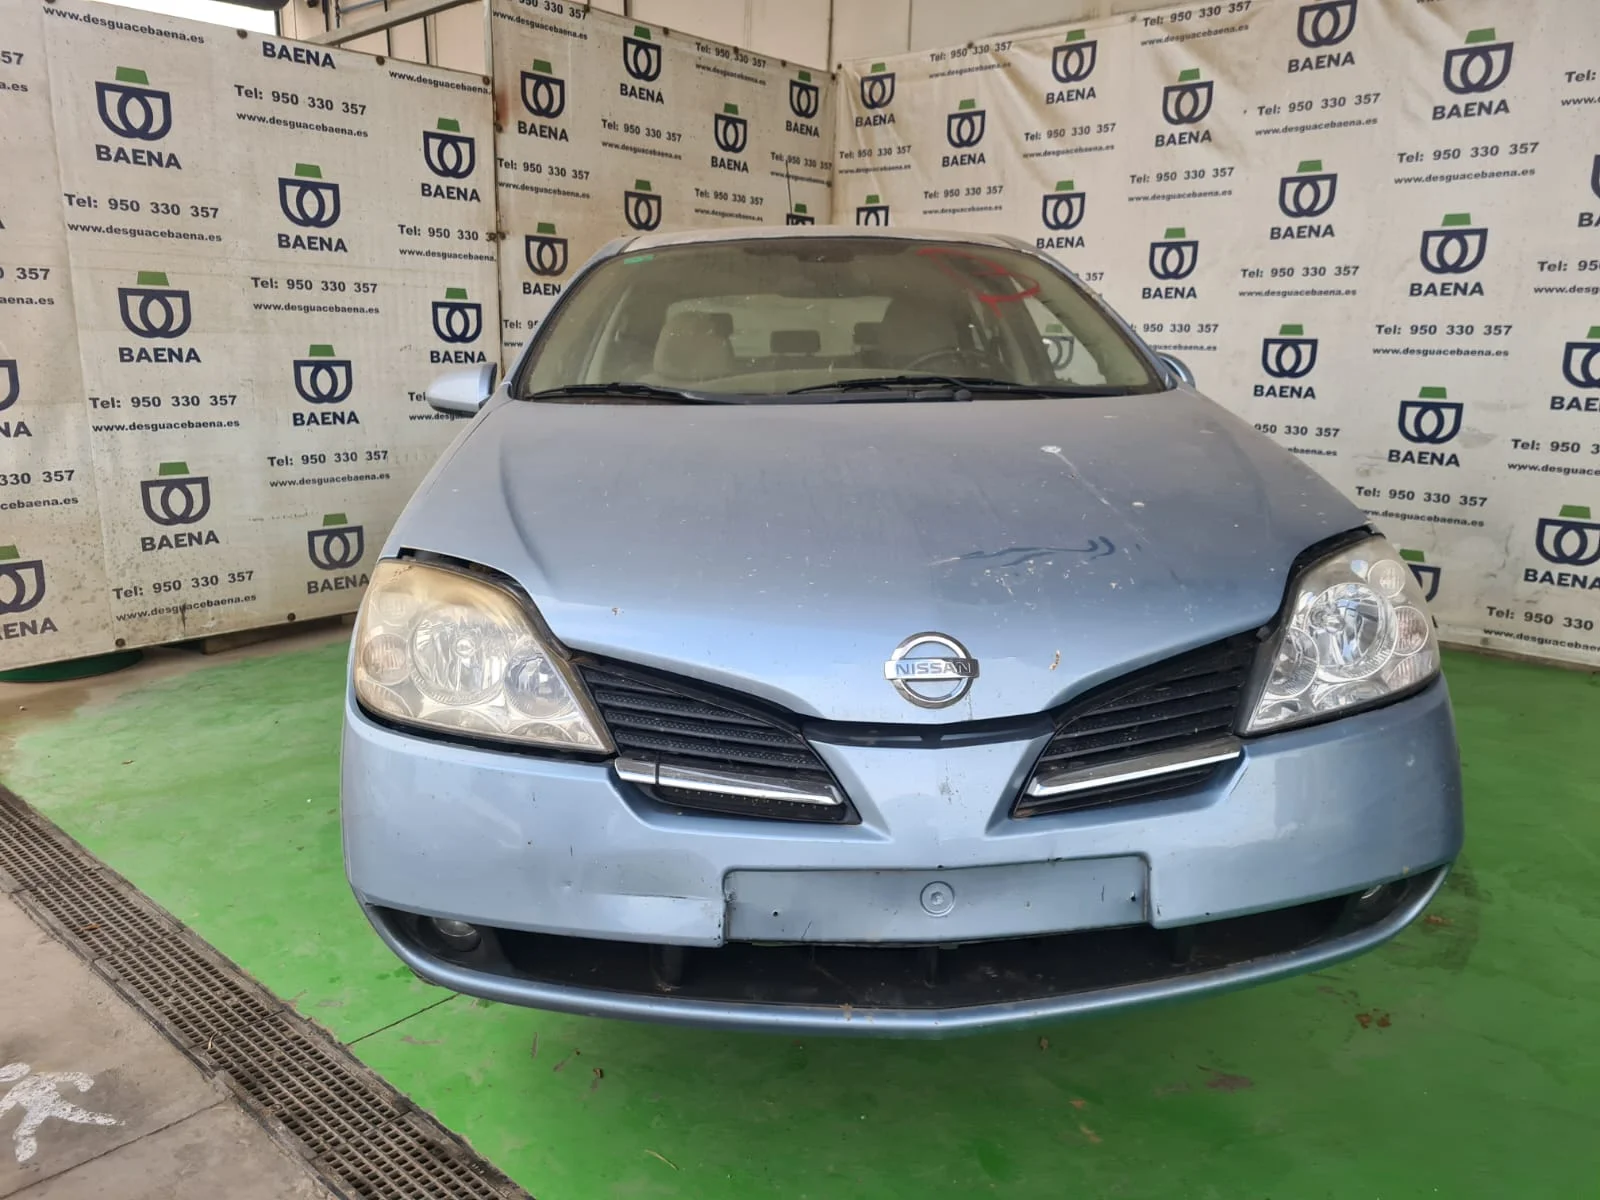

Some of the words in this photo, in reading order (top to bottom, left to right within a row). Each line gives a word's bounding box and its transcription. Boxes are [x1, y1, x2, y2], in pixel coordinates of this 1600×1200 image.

[543, 0, 564, 15] 330
[1143, 16, 1164, 27] Tel:
[1170, 10, 1192, 23] 950
[1199, 5, 1221, 18] 330
[1228, 0, 1250, 14] 357
[43, 6, 204, 44] www.desguacebaena.es
[1, 50, 24, 65] 57
[262, 40, 336, 70] BAENA
[930, 52, 946, 62] Tel:
[950, 48, 968, 59] 950
[972, 44, 990, 55] 330
[994, 41, 1013, 52] 357
[1288, 51, 1355, 73] BAENA
[389, 71, 492, 95] www.desguacebaena.
[1565, 69, 1596, 83] Tel:
[234, 84, 263, 100] Tel:
[271, 91, 299, 105] 950
[308, 96, 334, 111] 330
[342, 102, 366, 115] 357
[620, 83, 664, 104] BAENA
[1045, 86, 1096, 105] BAENA
[1257, 104, 1280, 116] Tel:
[1288, 100, 1313, 113] 950
[1321, 97, 1346, 109] 330
[1354, 93, 1381, 105] 357
[1432, 99, 1510, 120] BAENA
[236, 113, 368, 137] www.desguacebaena.es
[786, 120, 820, 137] BAENA
[855, 113, 896, 127] BAENA
[1255, 118, 1377, 135] www.desguacebaena.es
[518, 120, 569, 142] BAENA
[601, 119, 618, 131] Tel:
[624, 123, 640, 135] 950
[645, 128, 662, 139] 330
[666, 131, 682, 142] 357
[1024, 132, 1041, 141] Tel:
[1047, 128, 1065, 139] 950
[1072, 126, 1090, 136] 330
[1097, 123, 1116, 133] 357
[1155, 129, 1212, 147] BAENA
[95, 144, 182, 170] BAENA
[942, 152, 986, 168] BAENA
[1397, 152, 1424, 163] Tel:
[1433, 148, 1461, 160] 950
[1470, 145, 1499, 158] 330
[1509, 142, 1539, 155] 357
[497, 157, 517, 170] Tel:
[523, 162, 542, 174] 950
[548, 165, 566, 177] 330
[572, 169, 590, 180] 357
[711, 156, 749, 173] BAENA
[1130, 174, 1149, 184] Tel:
[1156, 172, 1177, 182] 950
[1184, 169, 1205, 180] 330
[1212, 167, 1234, 178] 357
[1394, 169, 1535, 184] www.desguacebaena.es
[421, 182, 481, 203] BAENA
[64, 193, 98, 208] Tel:
[108, 198, 140, 212] 950
[150, 202, 180, 216] 330
[190, 205, 219, 219] 357
[67, 224, 222, 242] www.desguacebaena.es
[398, 224, 421, 236] Tel:
[428, 227, 450, 239] 950
[457, 229, 479, 241] 330
[1270, 224, 1335, 240] BAENA
[277, 233, 348, 253] BAENA
[1036, 236, 1085, 249] BAENA
[399, 249, 497, 262] www.desguacebaena.
[16, 267, 50, 280] 357
[1241, 268, 1263, 278] Tel:
[1271, 267, 1294, 277] 950
[1302, 266, 1326, 277] 330
[1334, 265, 1359, 276] 357
[1537, 260, 1567, 272] Tel:
[250, 277, 278, 289] Tel:
[286, 279, 313, 290] 950
[321, 280, 346, 292] 330
[354, 282, 378, 293] 357
[1142, 286, 1197, 299] BAENA
[1409, 282, 1484, 297] BAENA
[253, 302, 379, 314] www.desguacebaena.es
[503, 319, 522, 329] Tel:
[1143, 323, 1163, 332] 950
[1170, 324, 1191, 333] 330
[1197, 324, 1219, 333] 357
[1376, 324, 1401, 335] Tel:
[1410, 324, 1437, 335] 950
[1446, 325, 1474, 335] 330
[1483, 325, 1512, 336] 357
[118, 347, 202, 363] BAENA
[430, 350, 487, 364] BAENA
[1373, 347, 1509, 357] www.desguacebaena.es
[1253, 384, 1316, 400] BAENA
[88, 397, 121, 409] Tel:
[131, 396, 161, 408] 950
[171, 395, 200, 407] 330
[209, 394, 237, 406] 357
[92, 420, 240, 432] www.desguacebaena.es
[292, 410, 360, 427] BAENA
[1284, 425, 1308, 436] 330
[1315, 427, 1340, 437] 357
[1511, 439, 1540, 450] Tel:
[1550, 441, 1581, 453] 950
[267, 455, 293, 467] Tel:
[301, 454, 326, 465] 950
[334, 452, 358, 463] 330
[366, 450, 388, 461] 357
[1388, 449, 1460, 467] BAENA
[42, 469, 75, 483] 357
[269, 473, 390, 487] www.desguacebaena.es
[1356, 486, 1380, 497] Tel:
[1389, 489, 1415, 500] 950
[1424, 492, 1450, 504] 330
[1459, 495, 1487, 507] 357
[141, 530, 220, 552] BAENA
[112, 586, 143, 600] Tel:
[152, 580, 182, 594] 950
[191, 575, 219, 588] 330
[228, 570, 254, 583] 357
[307, 572, 370, 594] BAENA
[1487, 606, 1514, 619] Tel:
[1524, 612, 1554, 625] 950
[1563, 617, 1594, 631] 330
[895, 662, 972, 675] NISSAN
